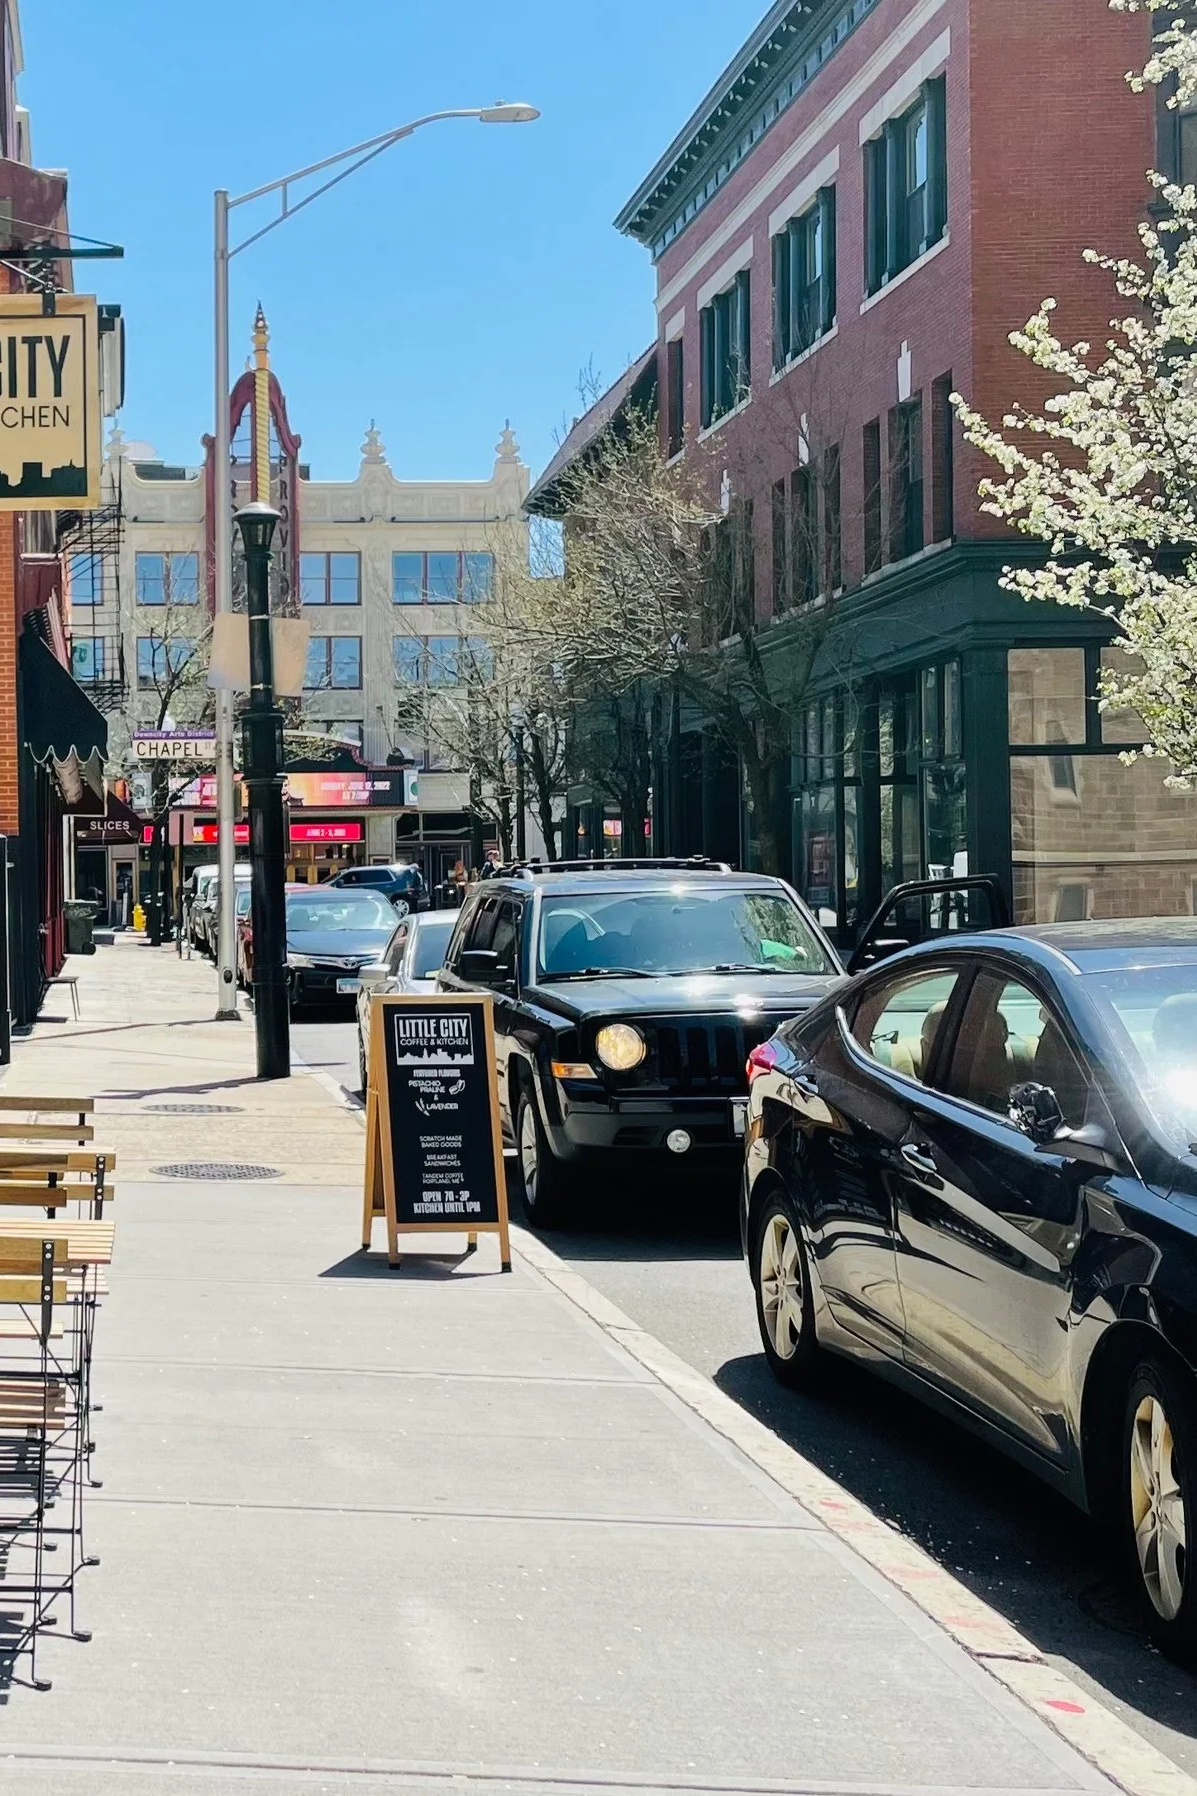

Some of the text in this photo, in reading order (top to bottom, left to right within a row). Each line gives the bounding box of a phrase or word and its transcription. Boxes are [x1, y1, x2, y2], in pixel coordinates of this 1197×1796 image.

[136, 741, 203, 756] CHAPEL
[90, 821, 130, 830] SLICES
[399, 1018, 467, 1037] LITTLE CITY
[400, 1038, 428, 1046] COFFEE
[422, 1191, 441, 1201] OPEN
[444, 1191, 454, 1201] 7A
[459, 1190, 470, 1201] 3P
[413, 1201, 481, 1213] KITCHEN UNTIL 1PM
